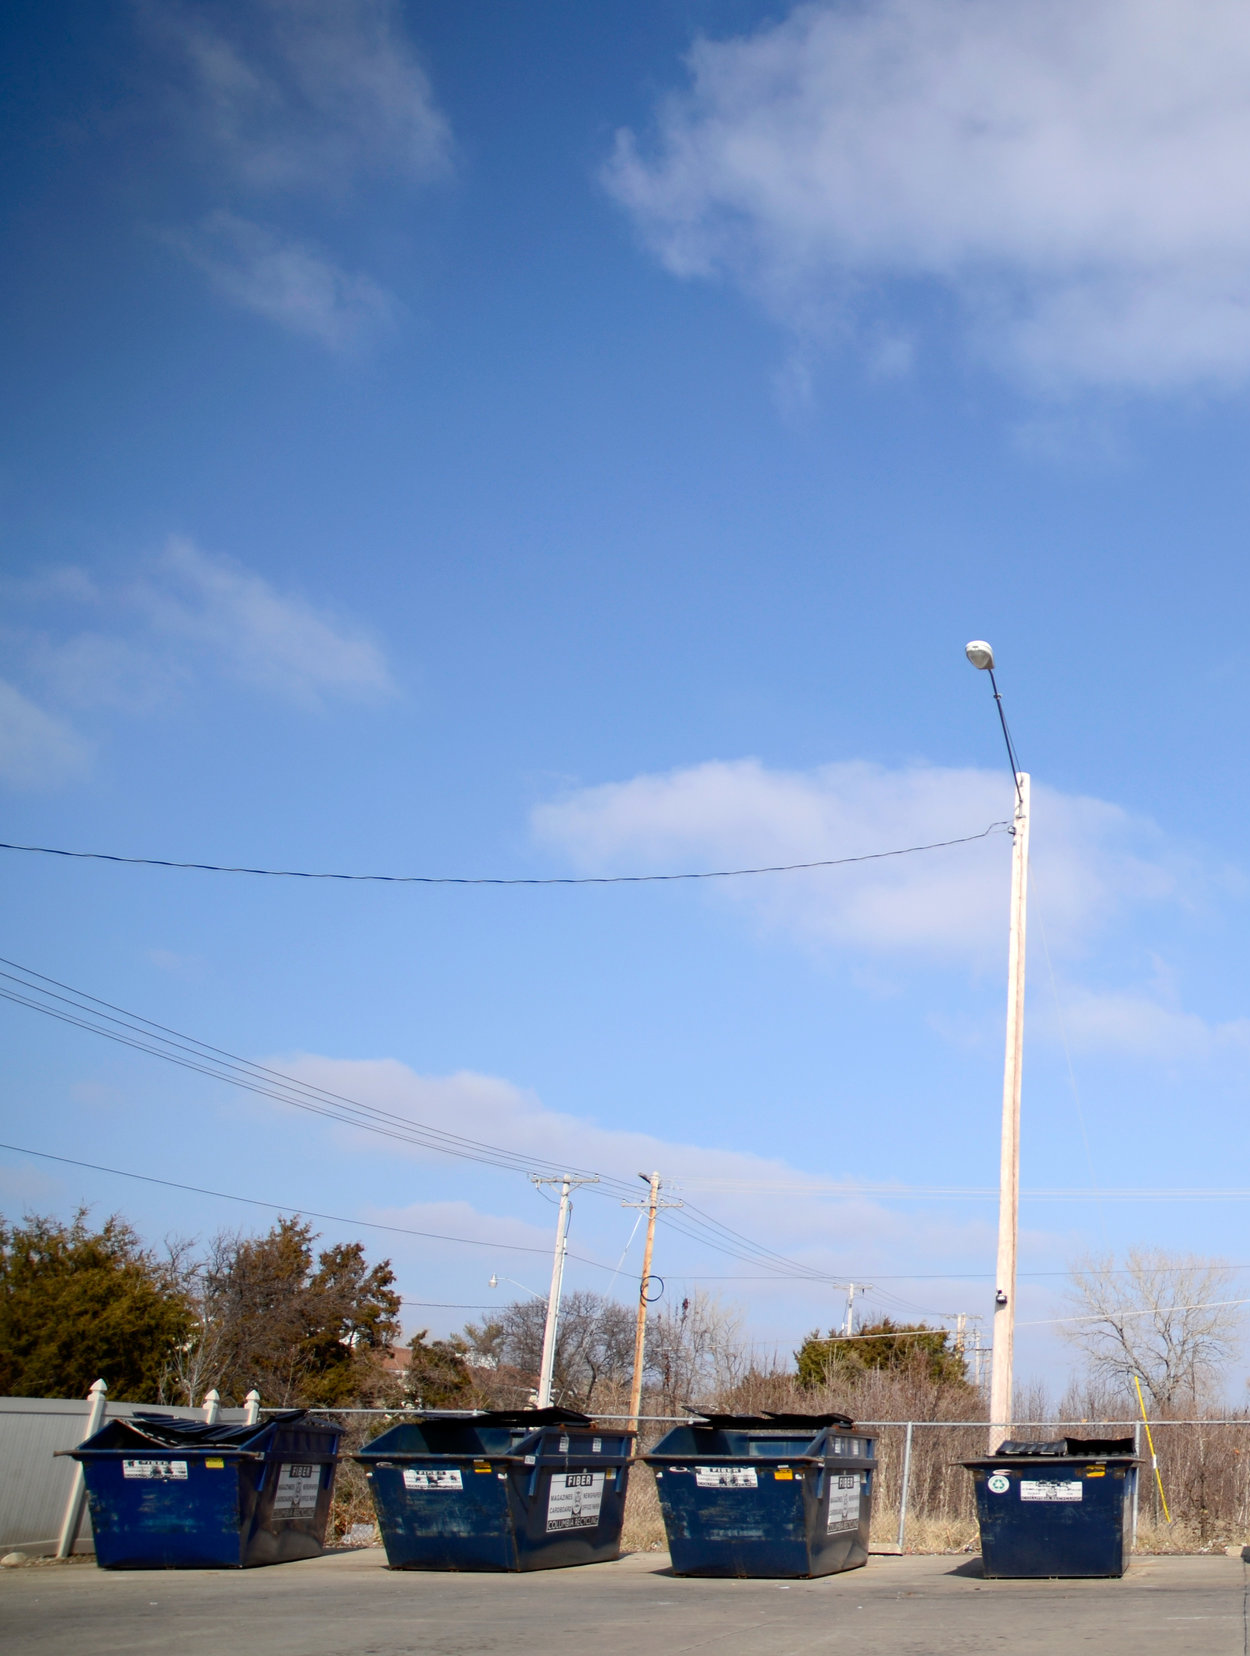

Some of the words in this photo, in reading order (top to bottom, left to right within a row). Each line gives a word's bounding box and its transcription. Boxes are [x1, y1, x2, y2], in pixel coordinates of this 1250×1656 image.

[291, 1465, 311, 1477] FIBER
[567, 1474, 591, 1487] FIBER
[839, 1477, 854, 1488] FIBER
[550, 1493, 573, 1501] MAGAZINES
[549, 1506, 572, 1514] CARDBOARD
[547, 1517, 575, 1530] COLUMBIA
[574, 1516, 599, 1528] RECYCLING
